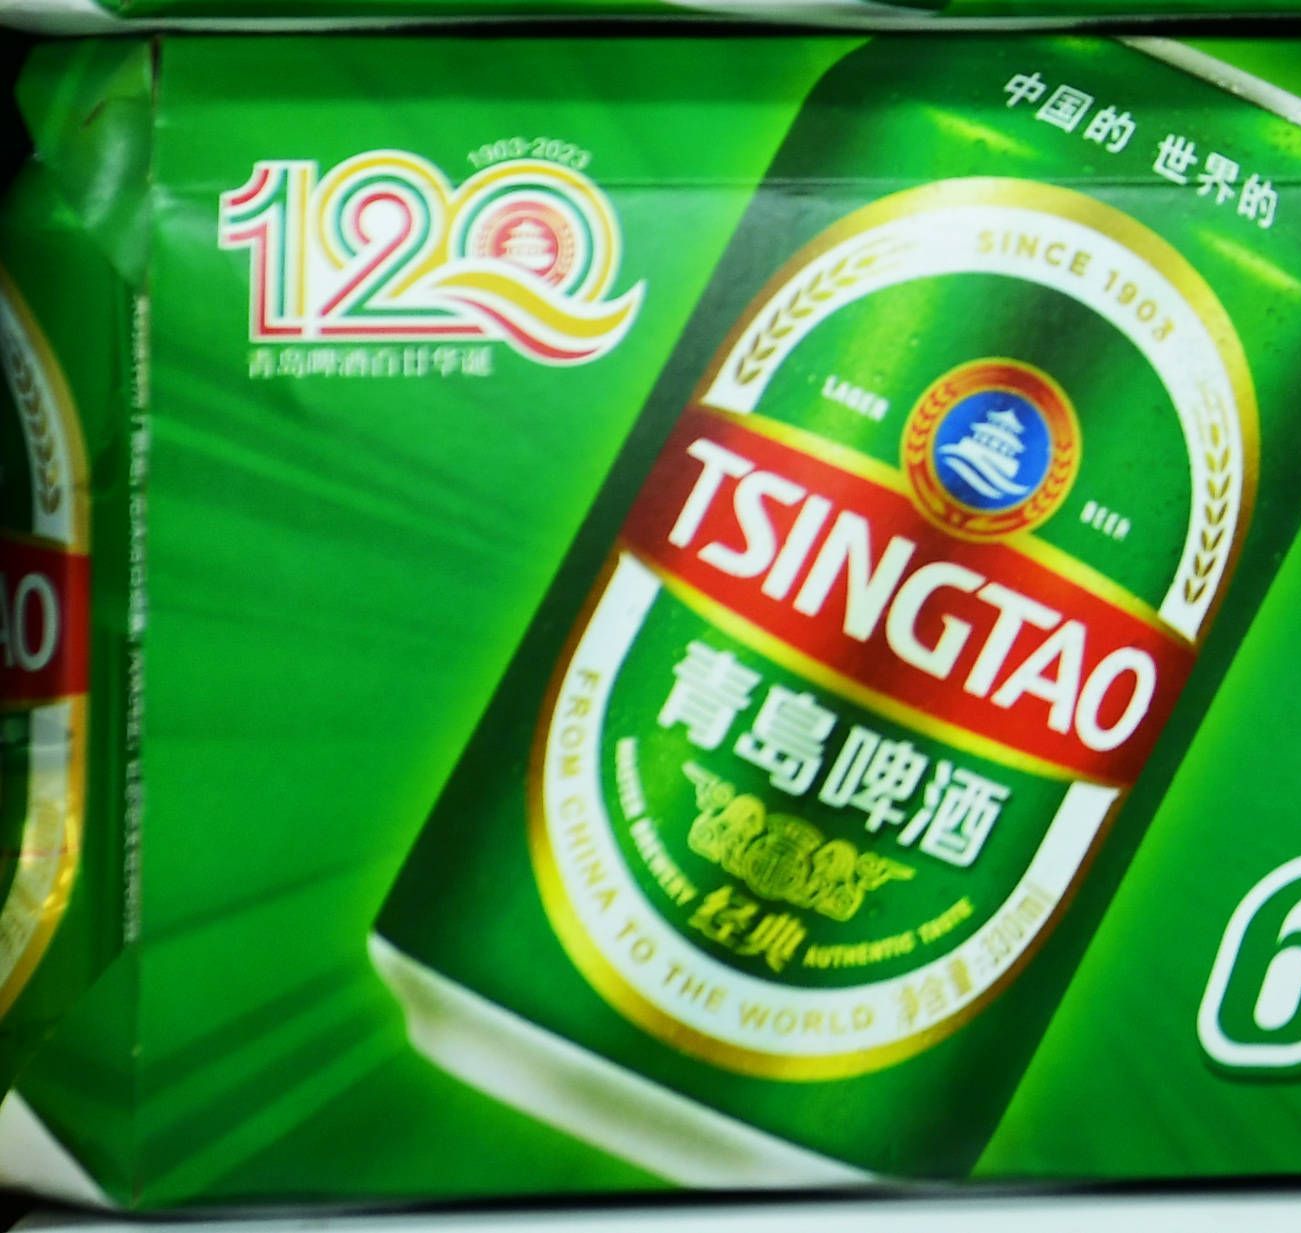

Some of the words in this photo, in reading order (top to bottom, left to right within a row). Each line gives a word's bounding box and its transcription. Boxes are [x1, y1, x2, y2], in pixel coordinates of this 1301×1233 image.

[467, 135, 592, 170] 1903-2023
[1003, 69, 1137, 155] 中国的
[1152, 133, 1280, 230] 世界的
[975, 227, 1089, 279] SINCE
[1102, 271, 1178, 344] 1903
[821, 373, 891, 423] LAGER
[1080, 500, 1132, 543] BEER
[668, 437, 1157, 752] TSINGTAO
[559, 668, 600, 781] FROM
[657, 639, 1012, 868] 青島啤酒
[559, 794, 618, 912] CHINA
[616, 920, 657, 966] TO
[688, 885, 806, 972] 经典
[661, 964, 725, 1014] THE
[738, 1001, 875, 1036] WORLD
